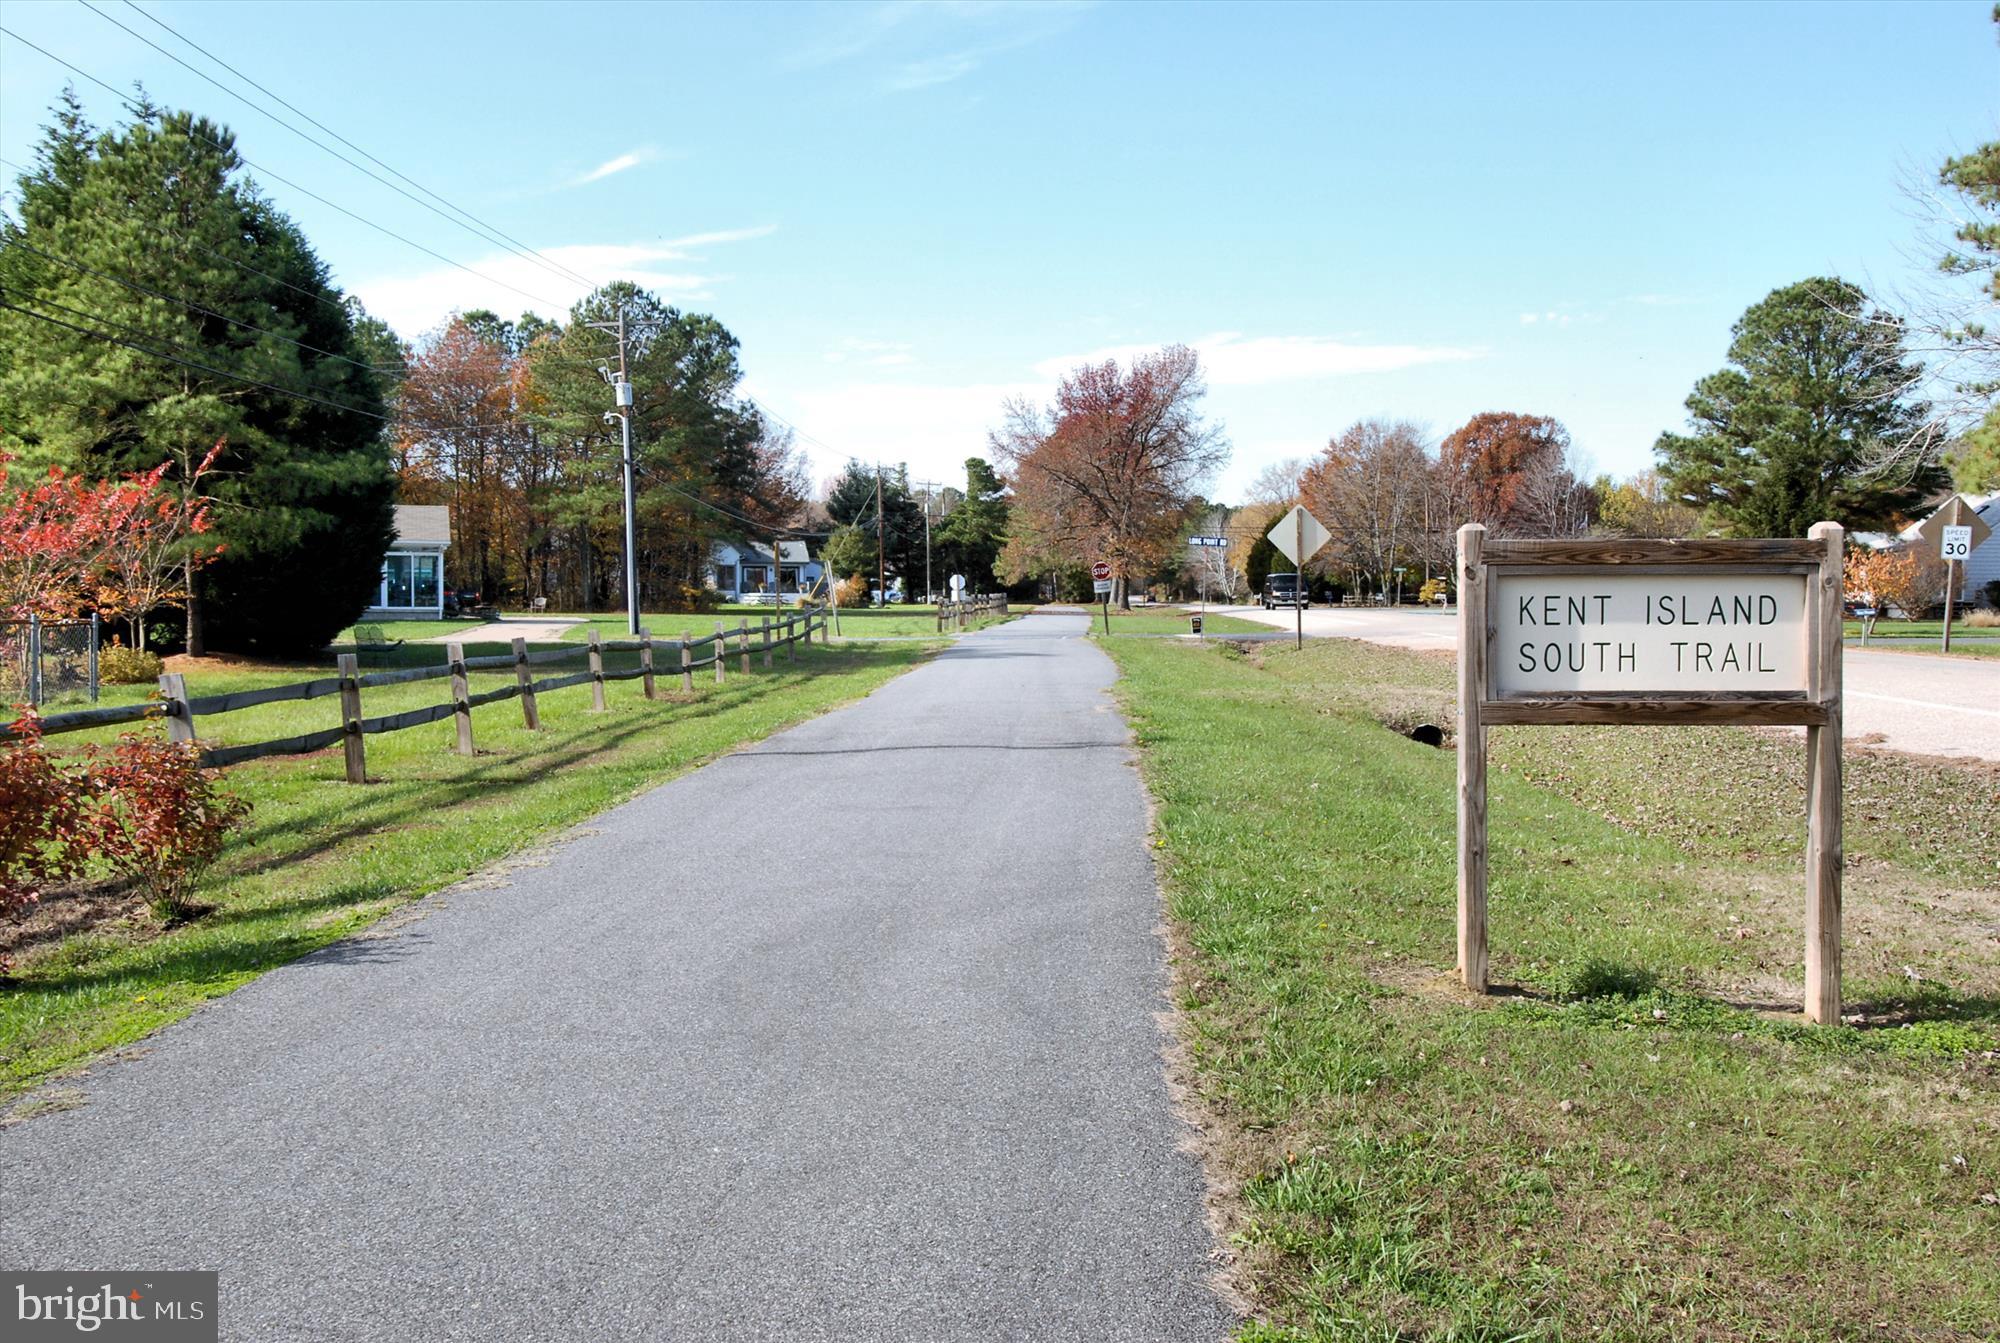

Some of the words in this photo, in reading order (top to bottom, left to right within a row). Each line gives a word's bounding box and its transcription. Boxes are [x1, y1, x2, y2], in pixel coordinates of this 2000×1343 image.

[1188, 537, 1202, 545] LONG
[1203, 538, 1218, 546] POINT
[1219, 538, 1227, 546] RD
[1945, 543, 1967, 555] 30
[1093, 567, 1110, 576] STOP
[1519, 595, 1612, 625] KENT
[1646, 595, 1777, 625] ISLAND
[1518, 642, 1636, 672] SOUTH
[1670, 642, 1776, 672] TRAIL
